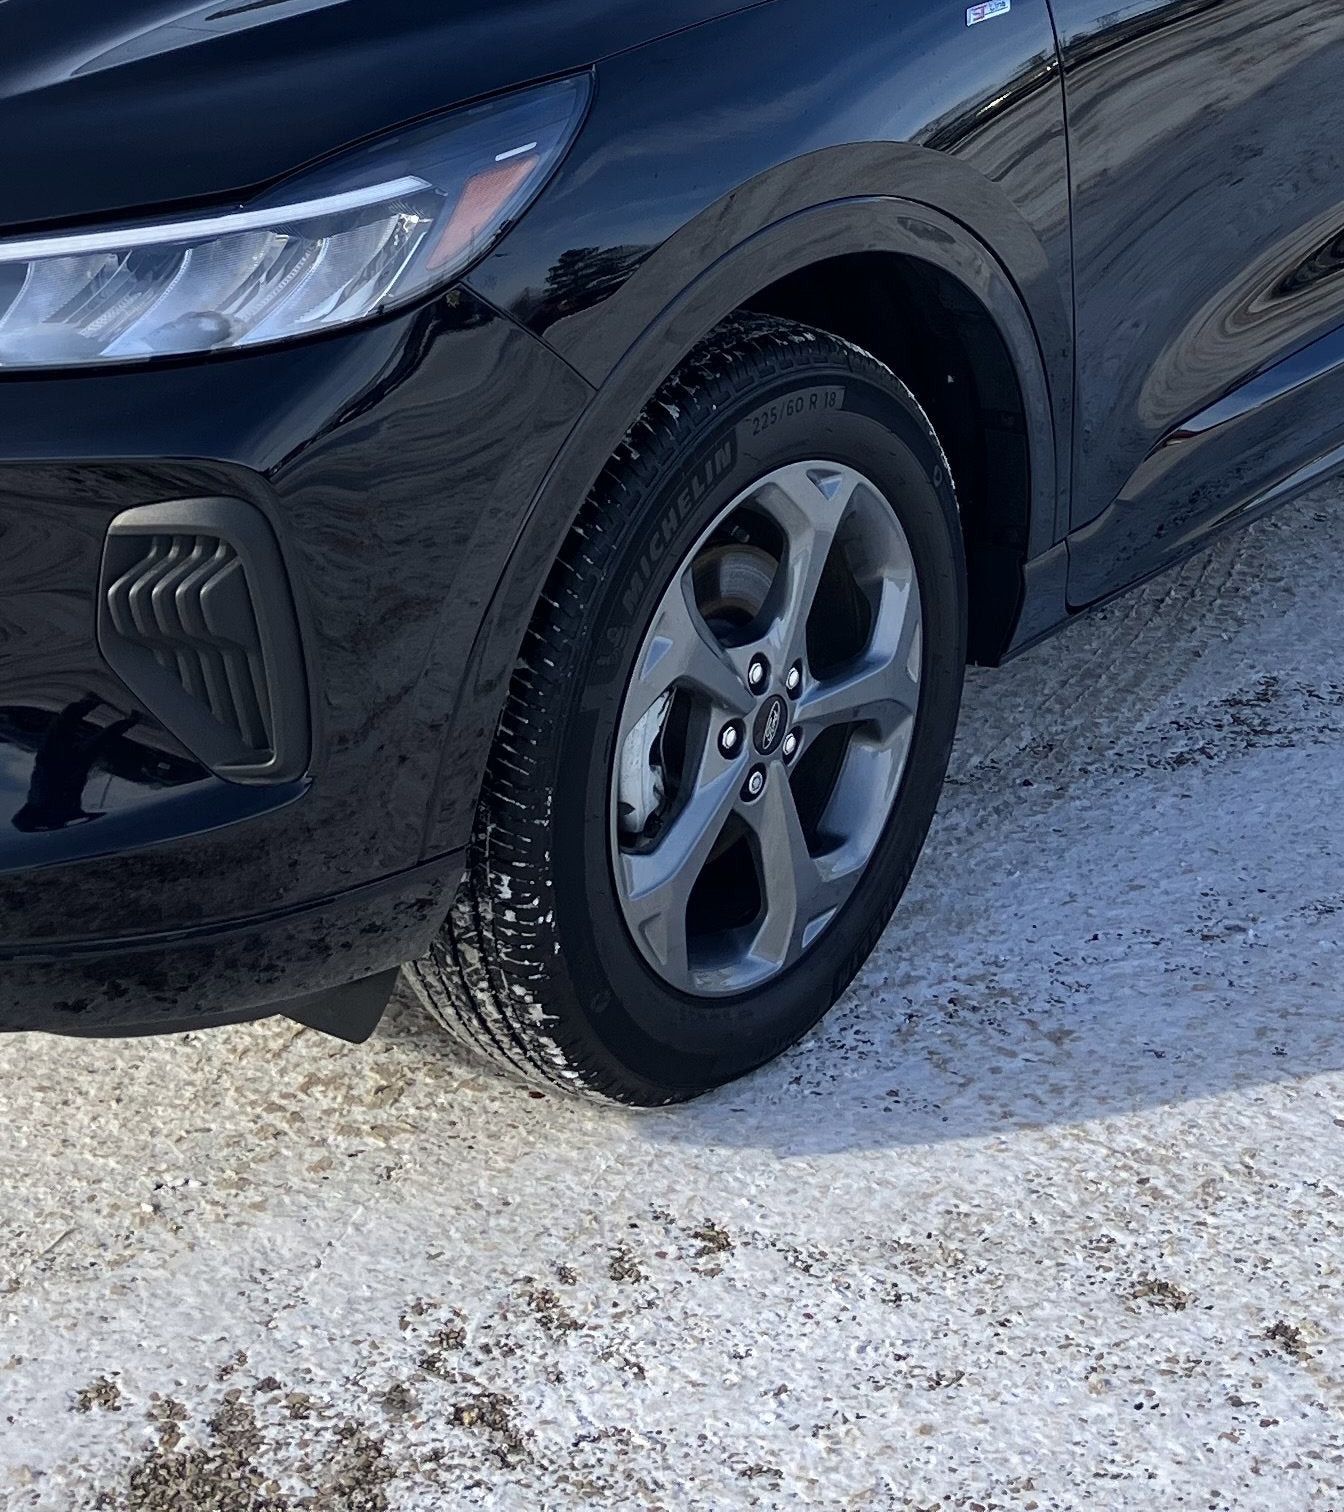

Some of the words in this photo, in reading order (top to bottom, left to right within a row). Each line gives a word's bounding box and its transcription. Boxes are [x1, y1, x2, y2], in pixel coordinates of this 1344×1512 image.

[752, 396, 805, 436] 225/60
[809, 393, 818, 410] R
[824, 391, 836, 409] 18
[622, 441, 733, 616] MICHELIN
